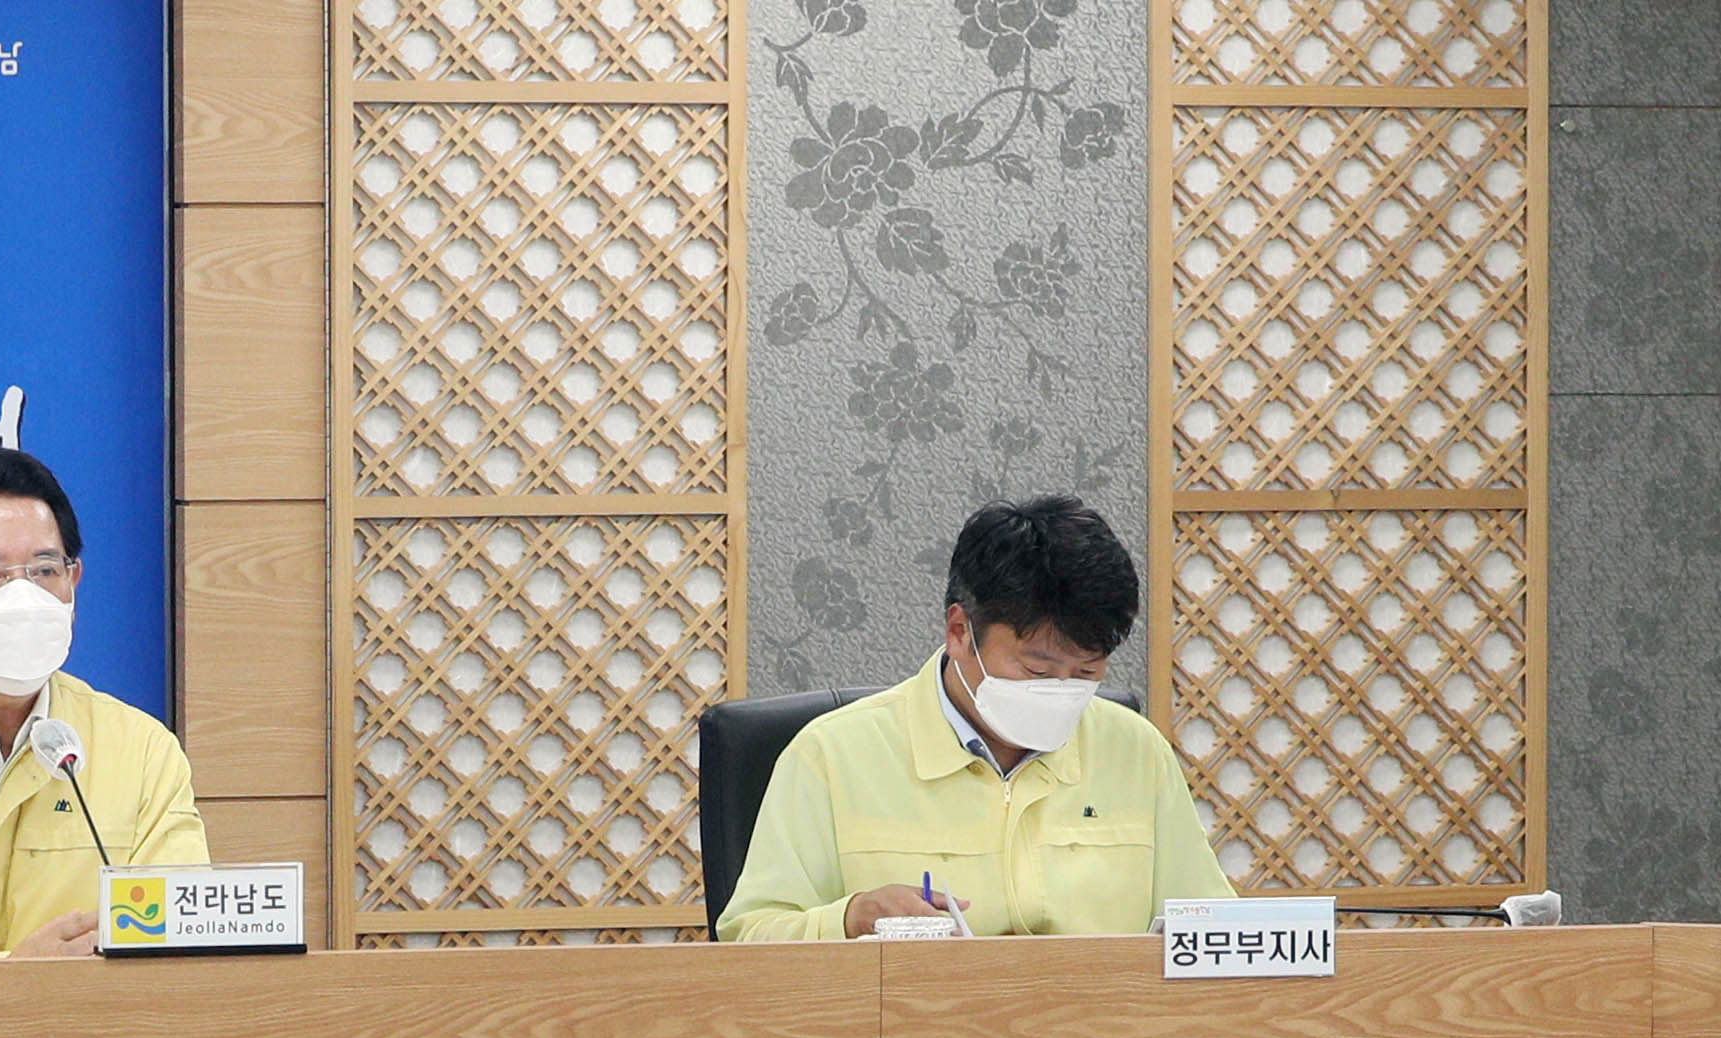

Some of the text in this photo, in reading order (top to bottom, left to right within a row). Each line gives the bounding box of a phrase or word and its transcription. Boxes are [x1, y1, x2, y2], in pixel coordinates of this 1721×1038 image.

[174, 884, 286, 916] 전라남도
[176, 919, 286, 935] JeollaNamdo
[1170, 929, 1331, 967] 정무부지사
